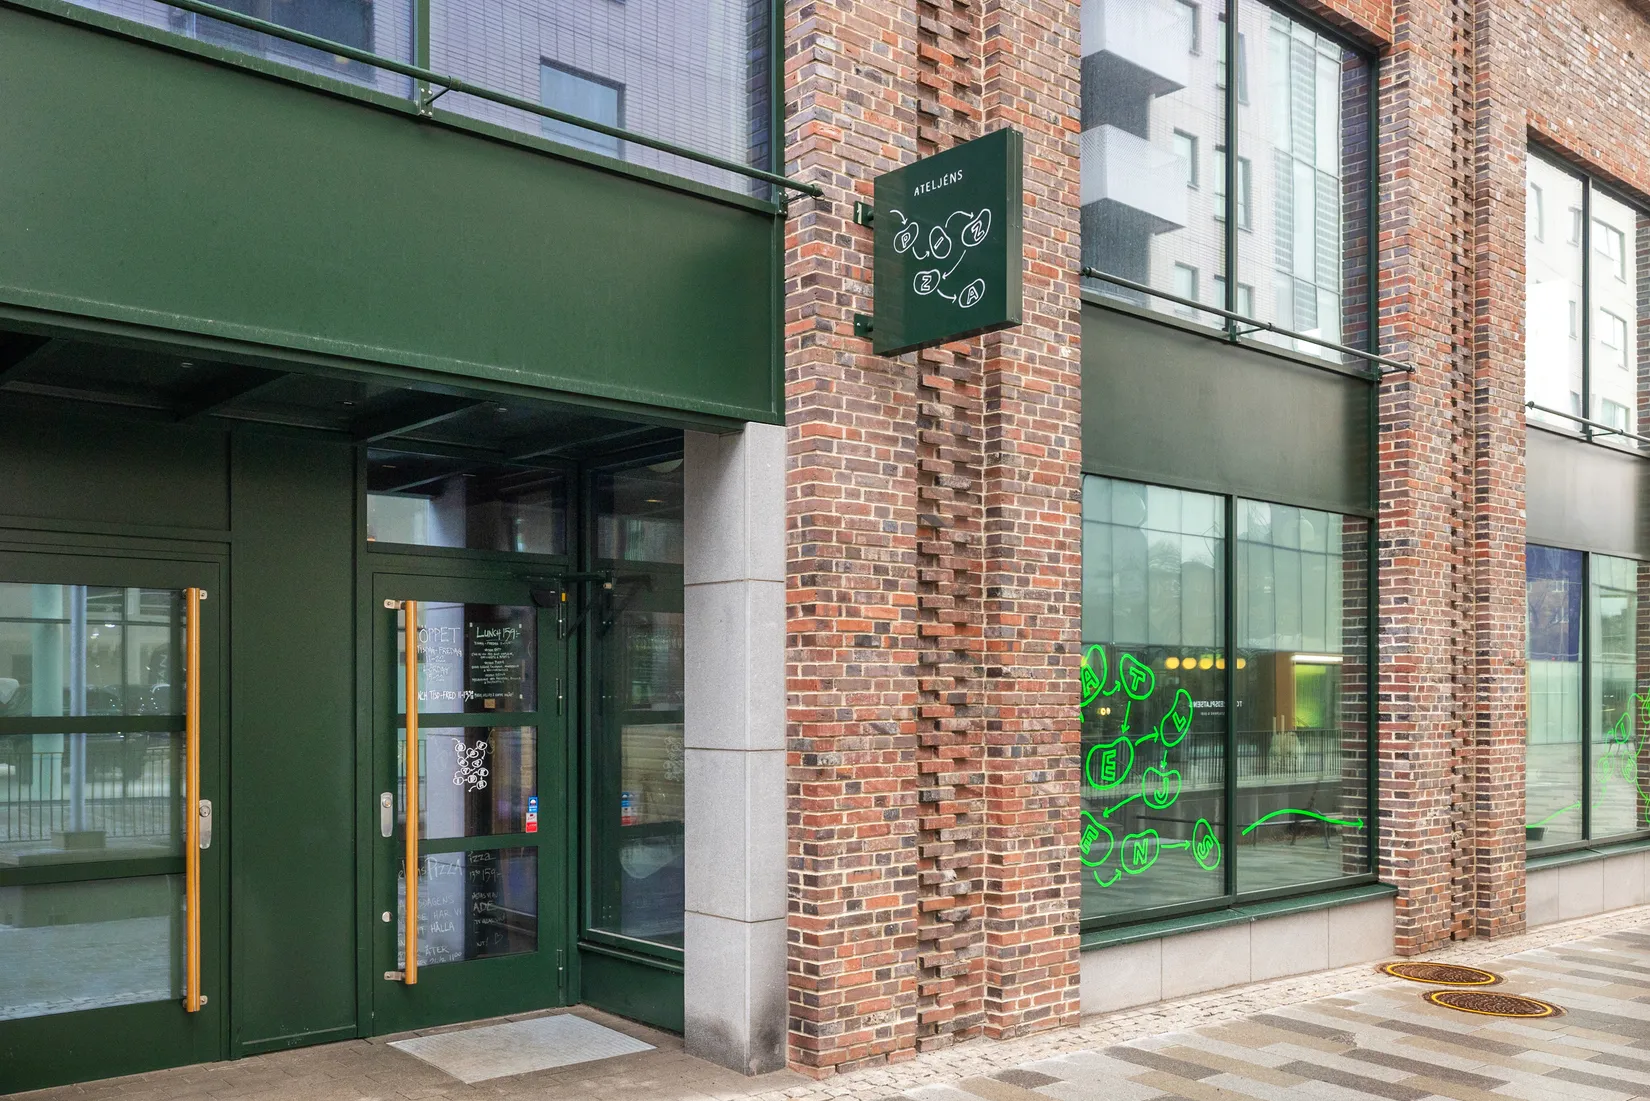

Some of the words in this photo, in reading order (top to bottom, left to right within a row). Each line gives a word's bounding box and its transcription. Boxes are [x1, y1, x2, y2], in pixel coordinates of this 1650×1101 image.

[913, 169, 963, 196] ATELJÉNS
[419, 625, 460, 643] ÖPPET
[476, 626, 501, 640] LUNCH
